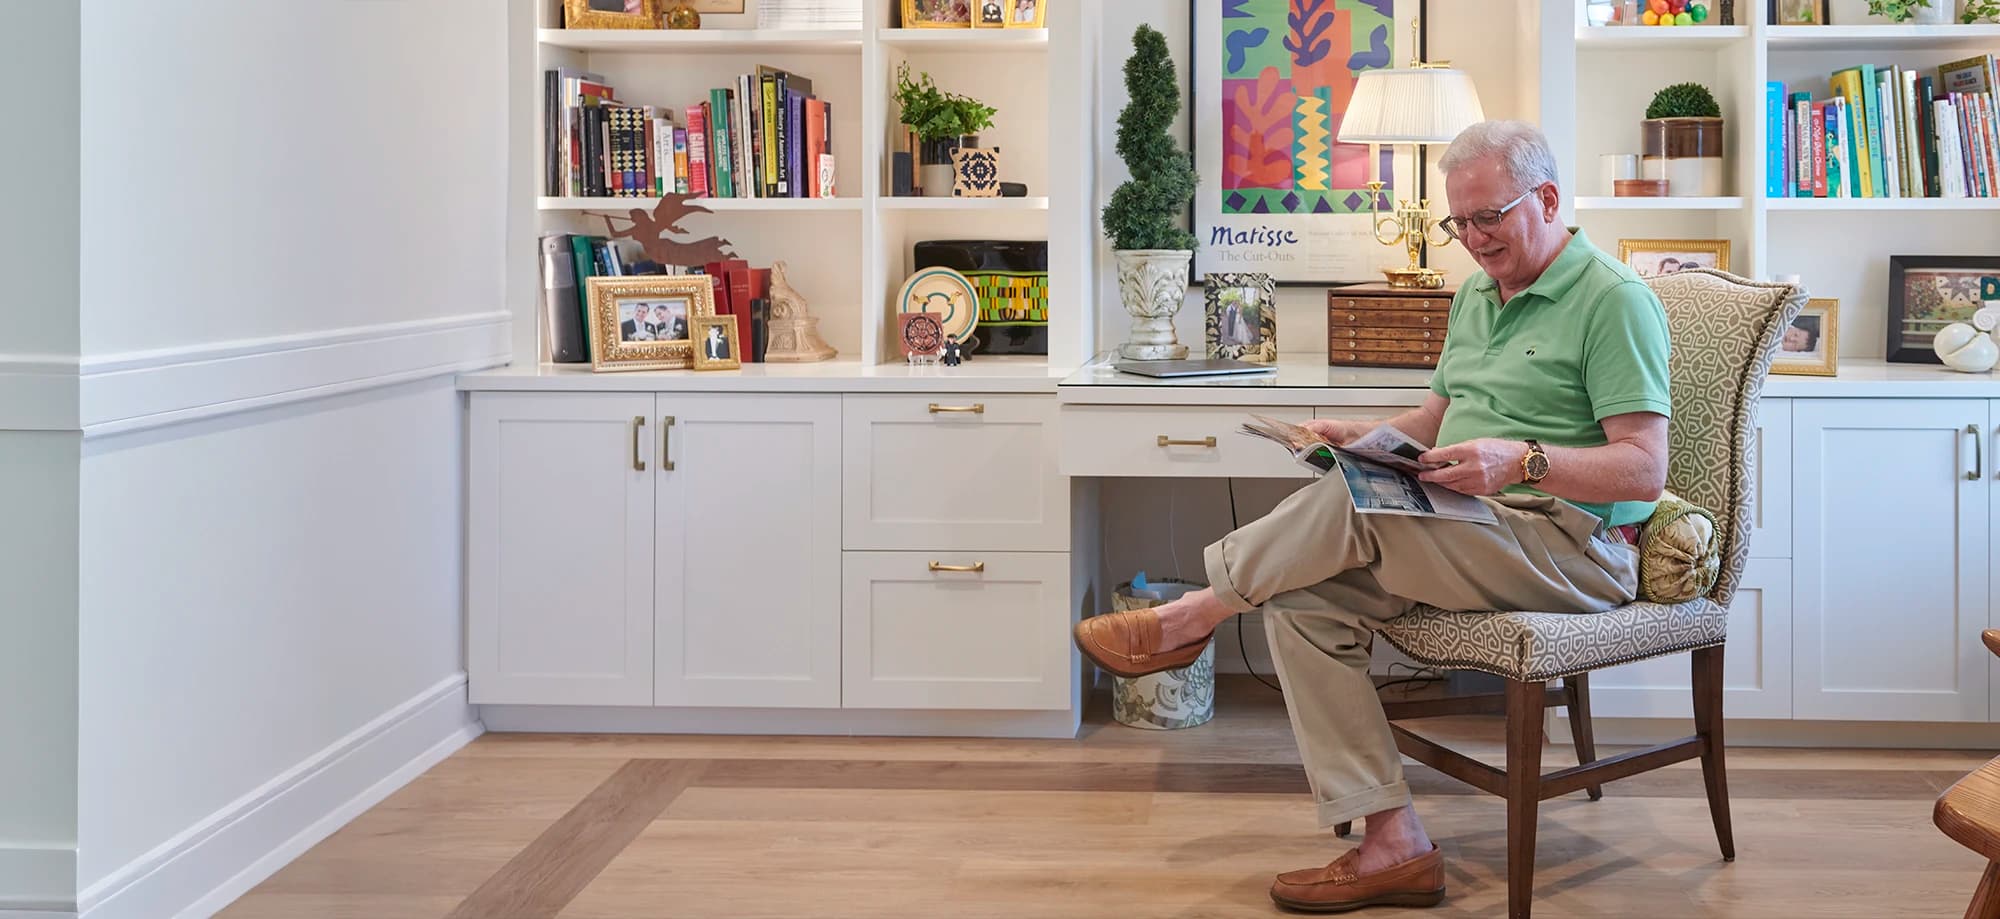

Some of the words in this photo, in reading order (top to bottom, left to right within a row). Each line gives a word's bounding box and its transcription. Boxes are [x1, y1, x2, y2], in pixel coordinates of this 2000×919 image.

[777, 108, 785, 131] History
[662, 132, 670, 147] Art
[689, 132, 705, 164] GAME
[1210, 225, 1298, 247] Matisse
[1218, 251, 1241, 262] The
[1243, 251, 1296, 262] Cut-Outs
